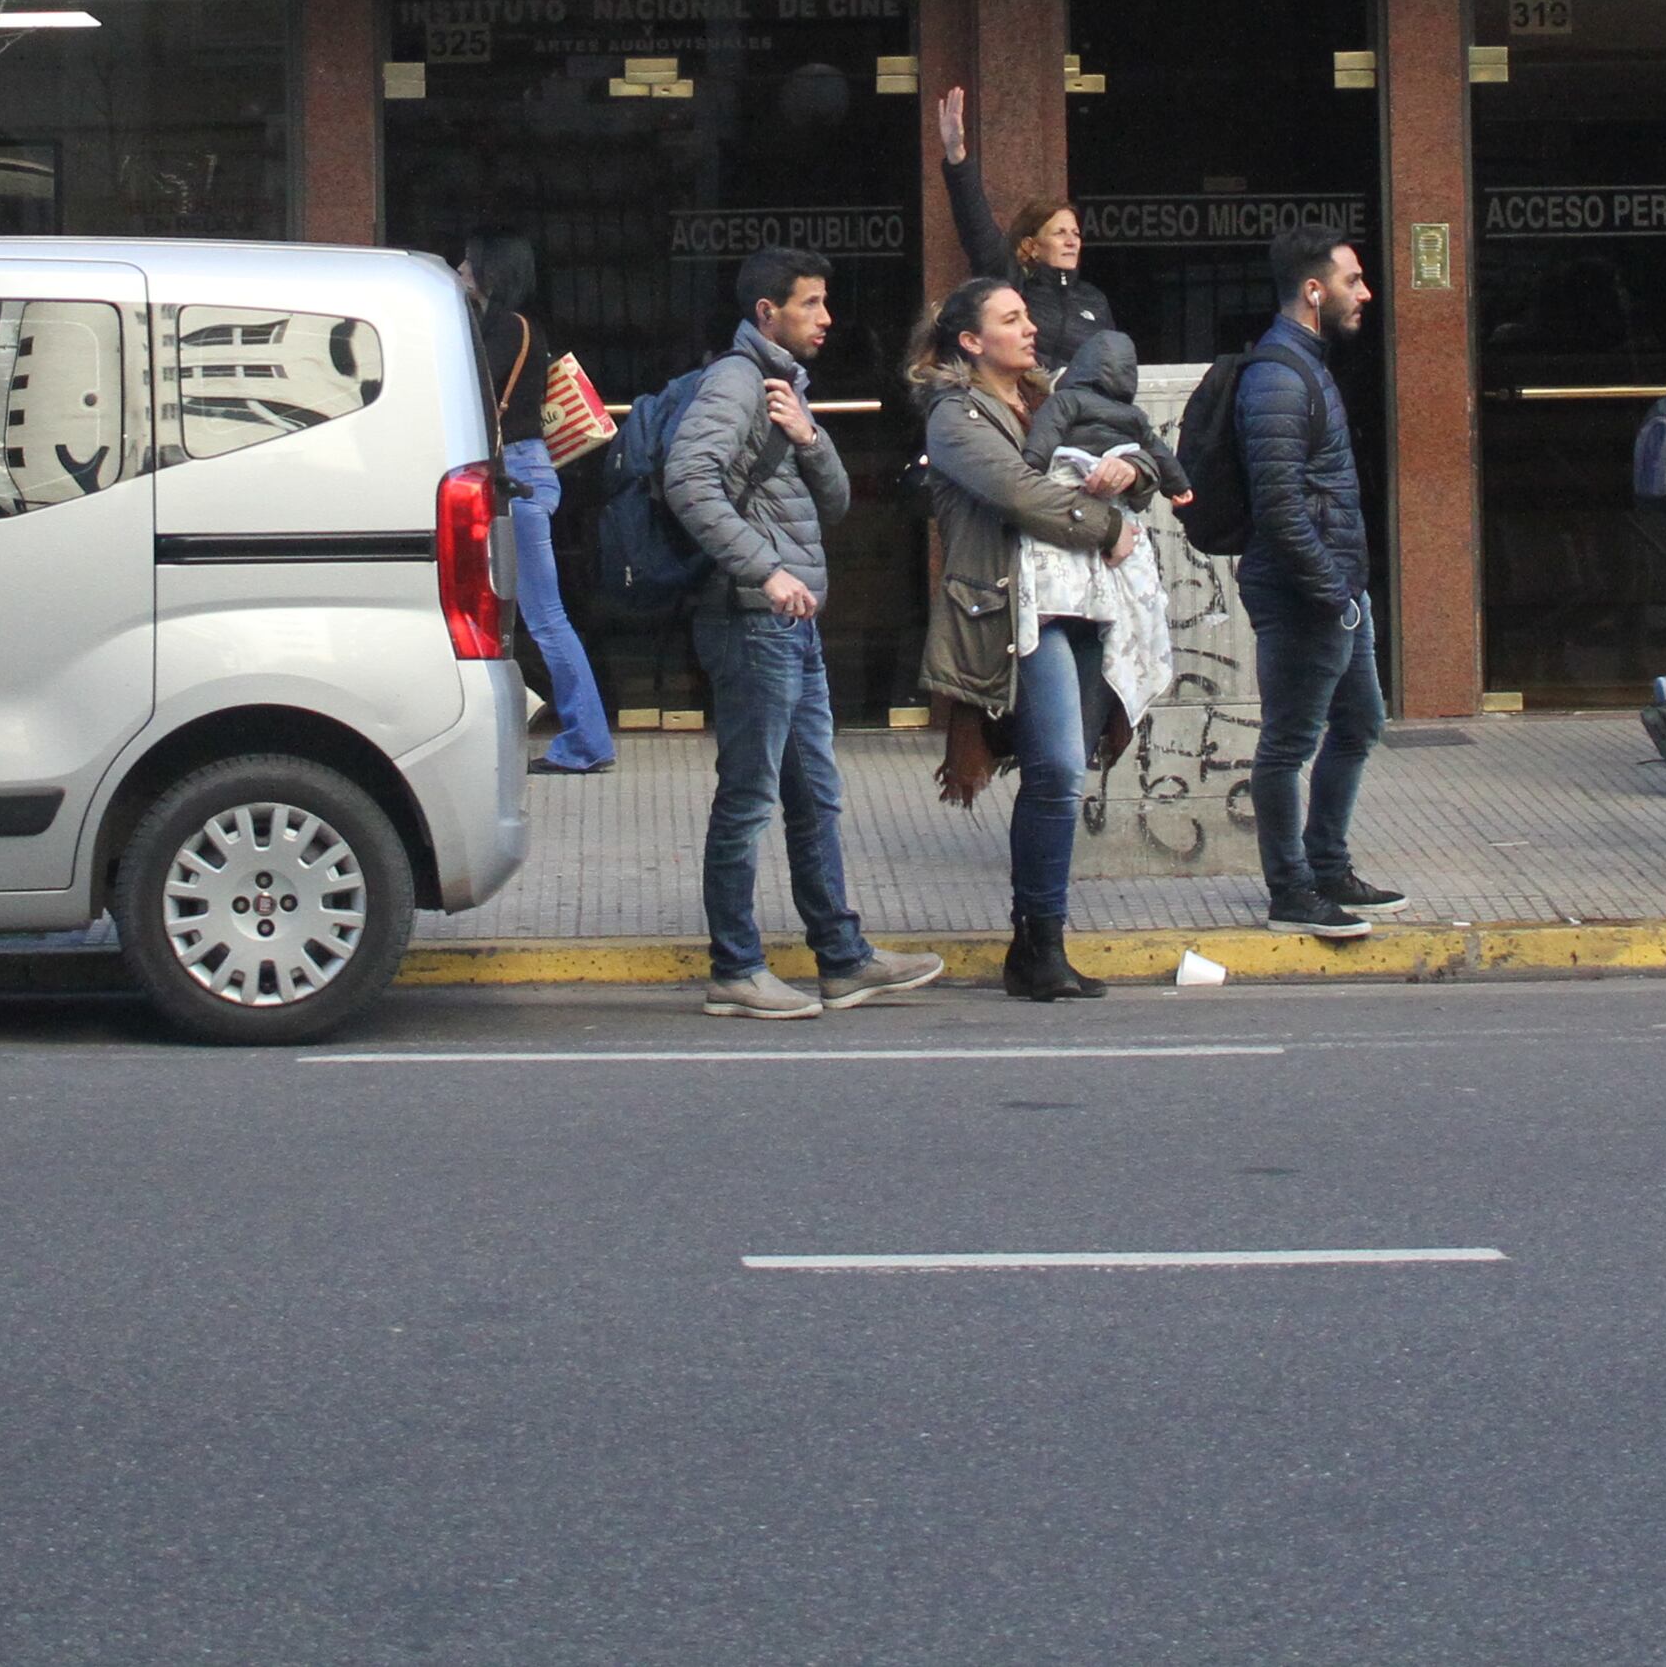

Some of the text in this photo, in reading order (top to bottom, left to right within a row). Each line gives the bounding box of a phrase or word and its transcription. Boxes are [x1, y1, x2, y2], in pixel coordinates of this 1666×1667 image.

[431, 28, 488, 57] 325
[1081, 203, 1366, 238] ACCESO MICROCINE
[1485, 195, 1605, 229] ACCESO
[672, 215, 905, 251] ACCESO PUBLICO
